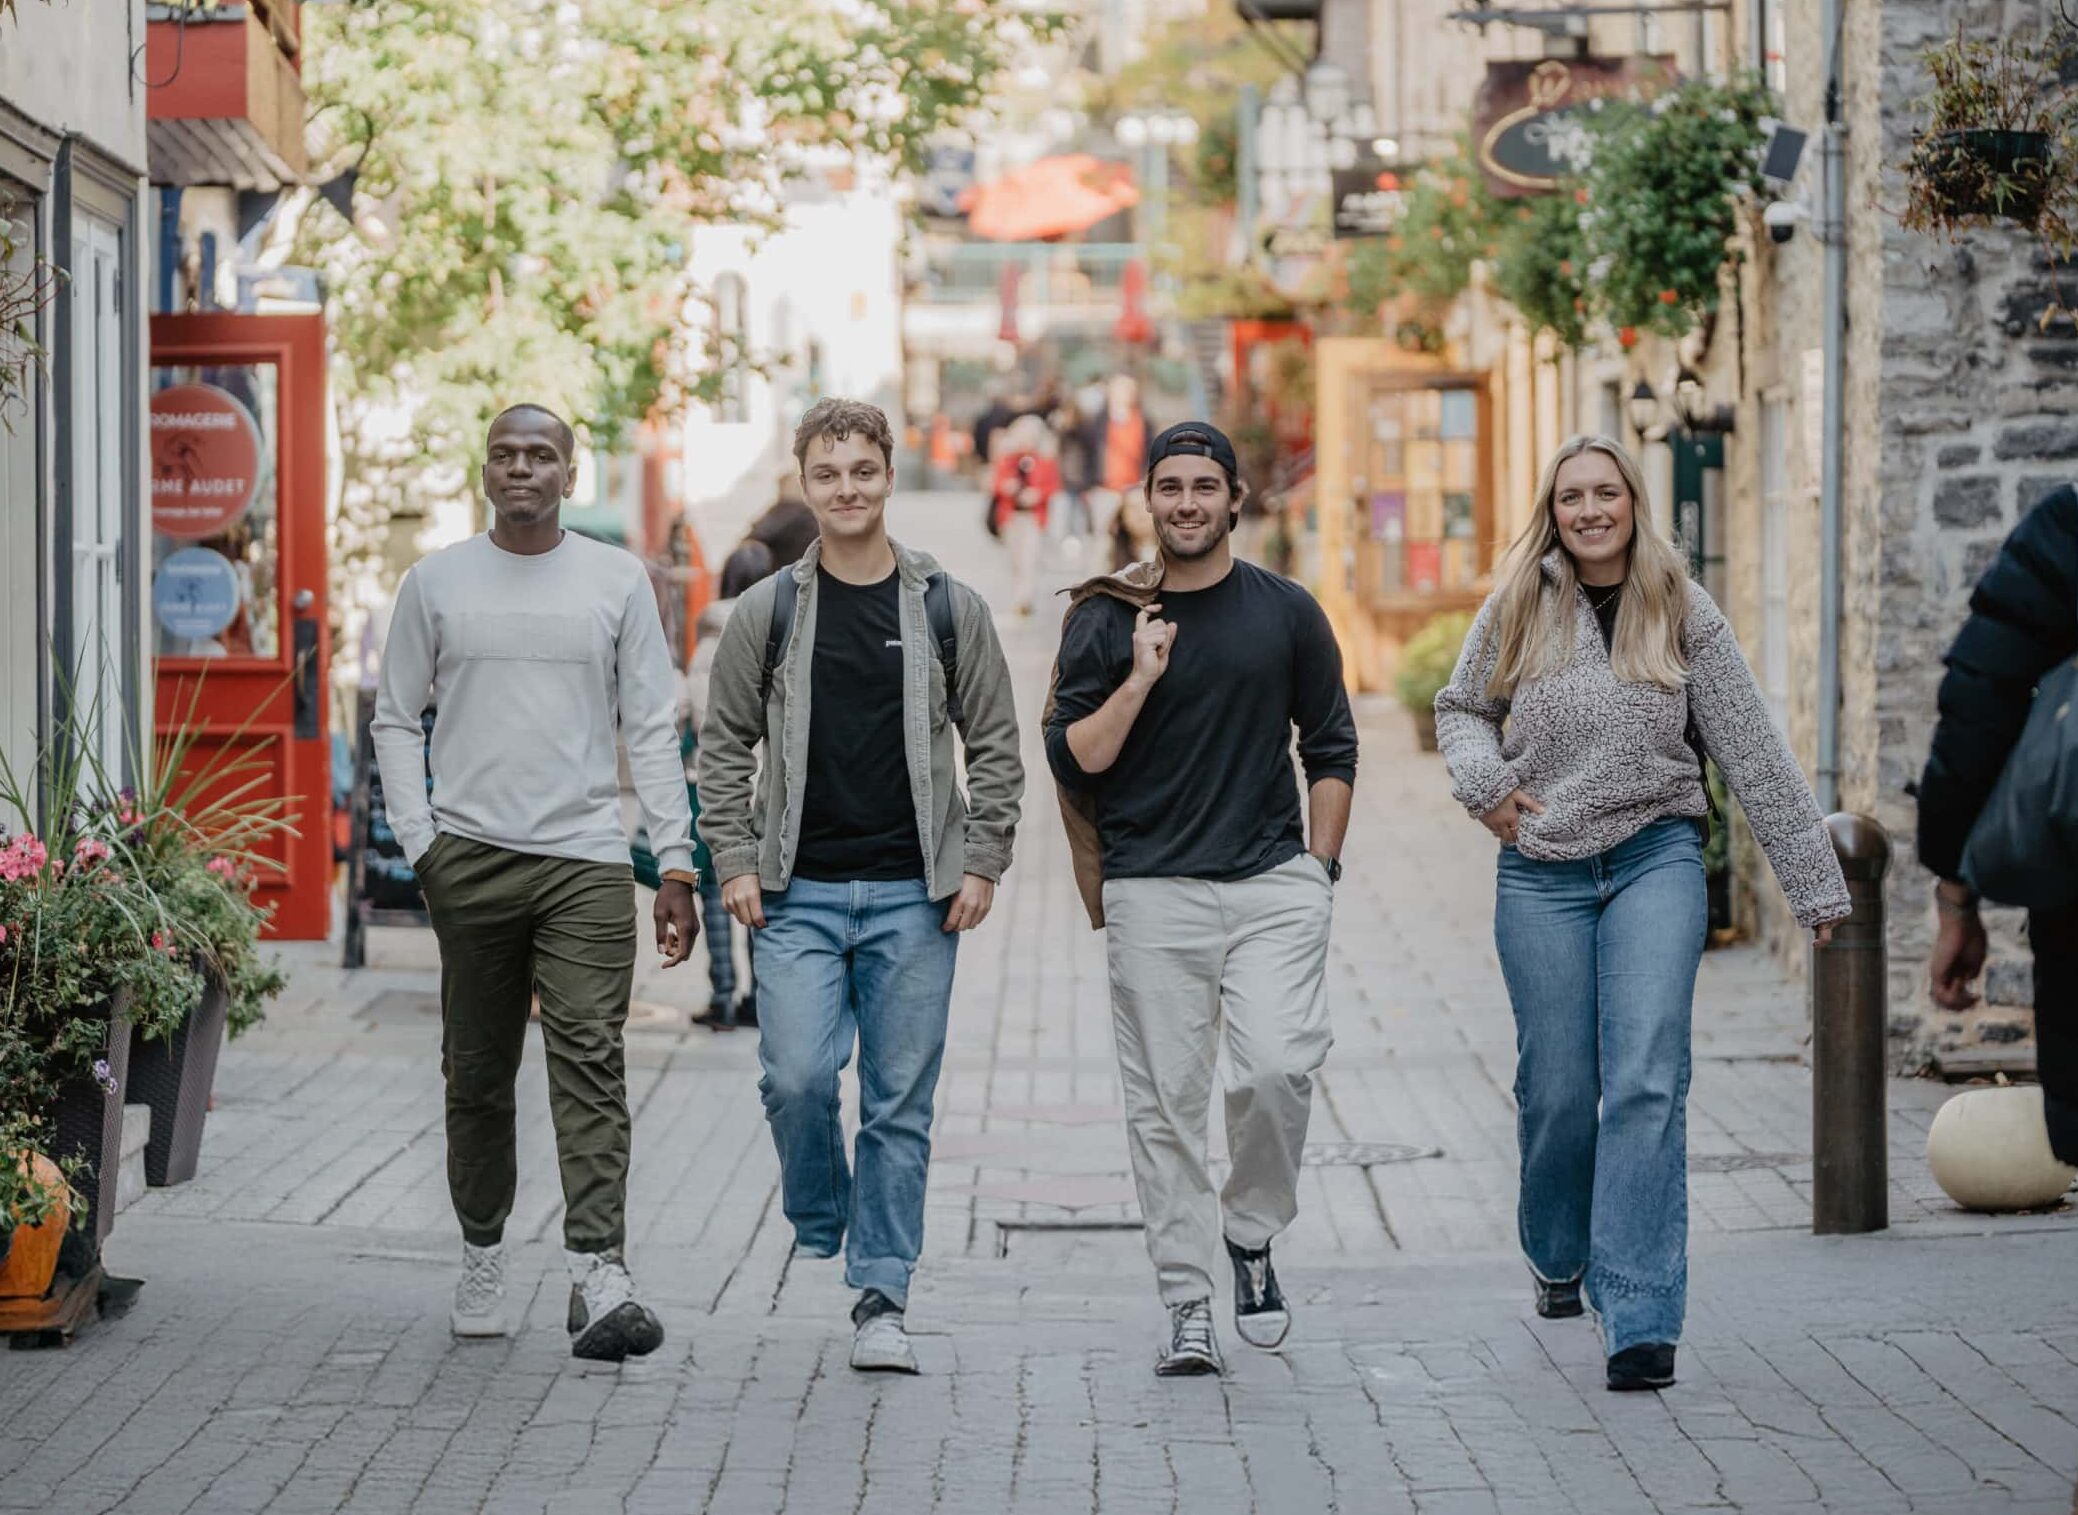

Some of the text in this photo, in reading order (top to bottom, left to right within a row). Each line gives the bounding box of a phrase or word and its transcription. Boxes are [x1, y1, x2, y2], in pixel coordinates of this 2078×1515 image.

[151, 412, 236, 428] ROMAGERIE
[152, 478, 245, 494] RME AUDET
